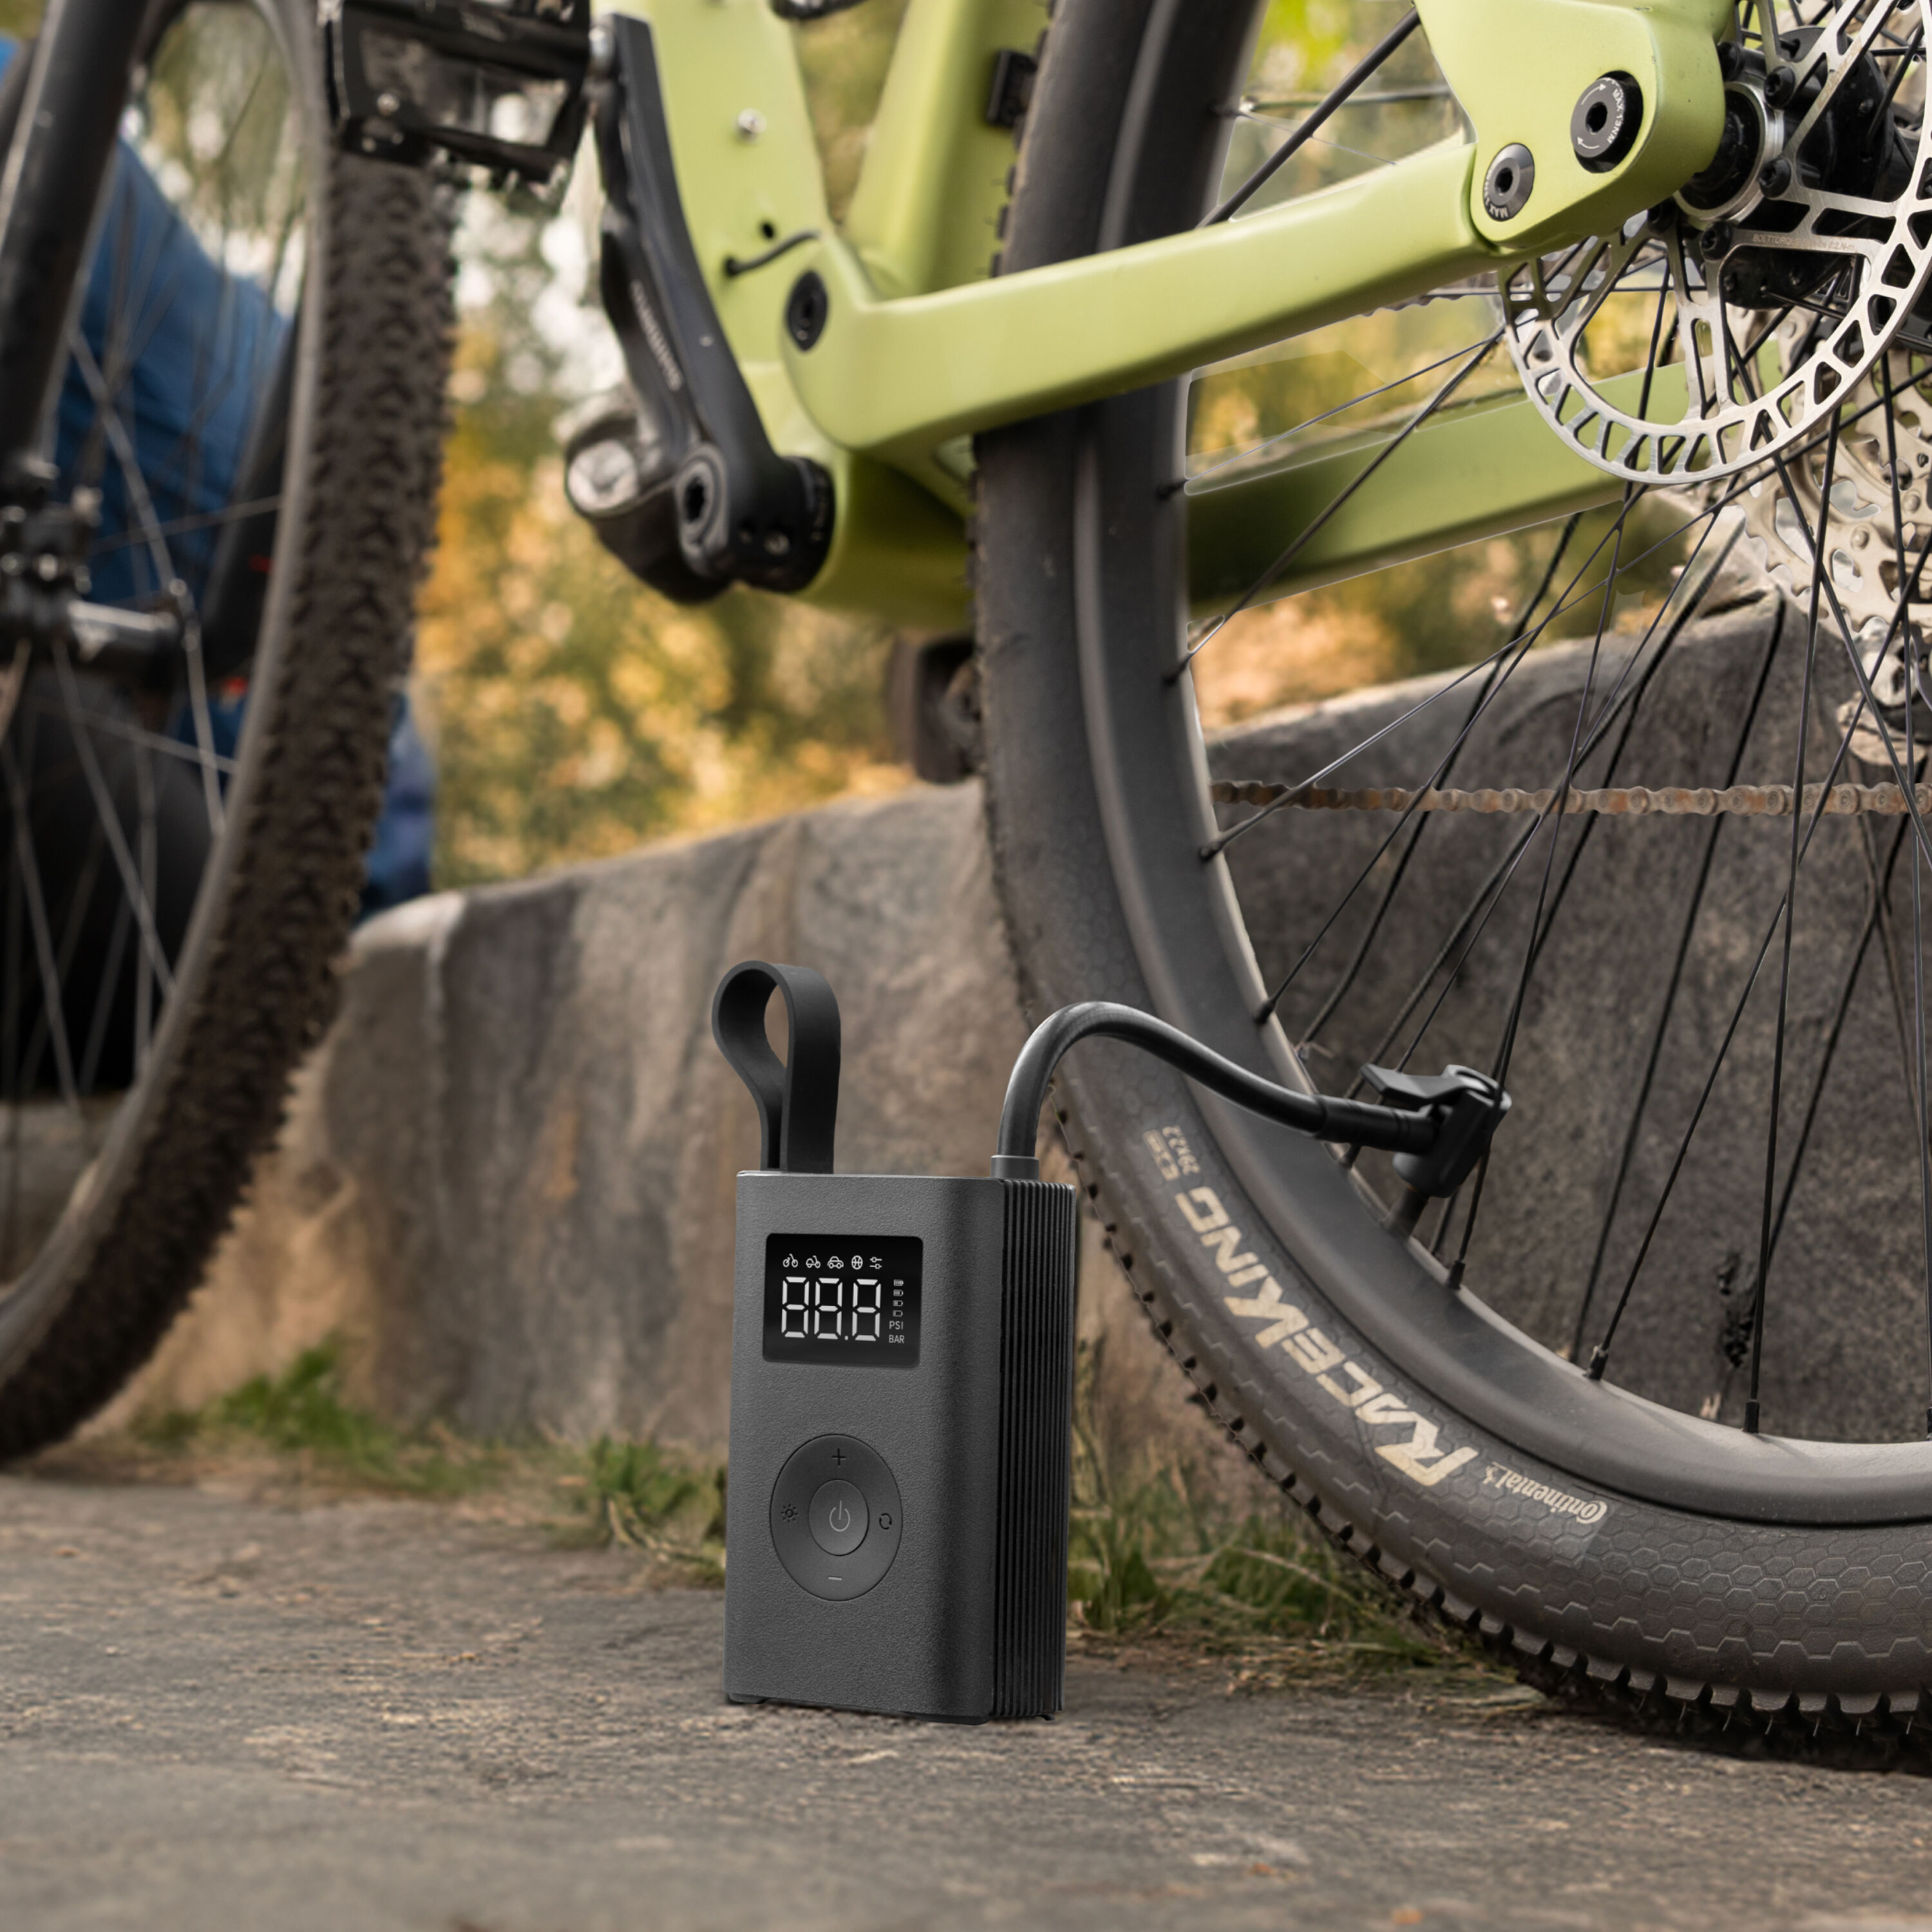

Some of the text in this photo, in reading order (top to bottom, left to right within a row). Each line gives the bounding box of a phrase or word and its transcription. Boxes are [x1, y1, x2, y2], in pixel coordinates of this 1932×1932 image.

[1612, 88, 1624, 111] MAX
[781, 1276, 882, 1341] 88.8
[889, 1320, 904, 1330] PSI
[889, 1334, 905, 1344] BAR
[1494, 1469, 1607, 1524] Continental
